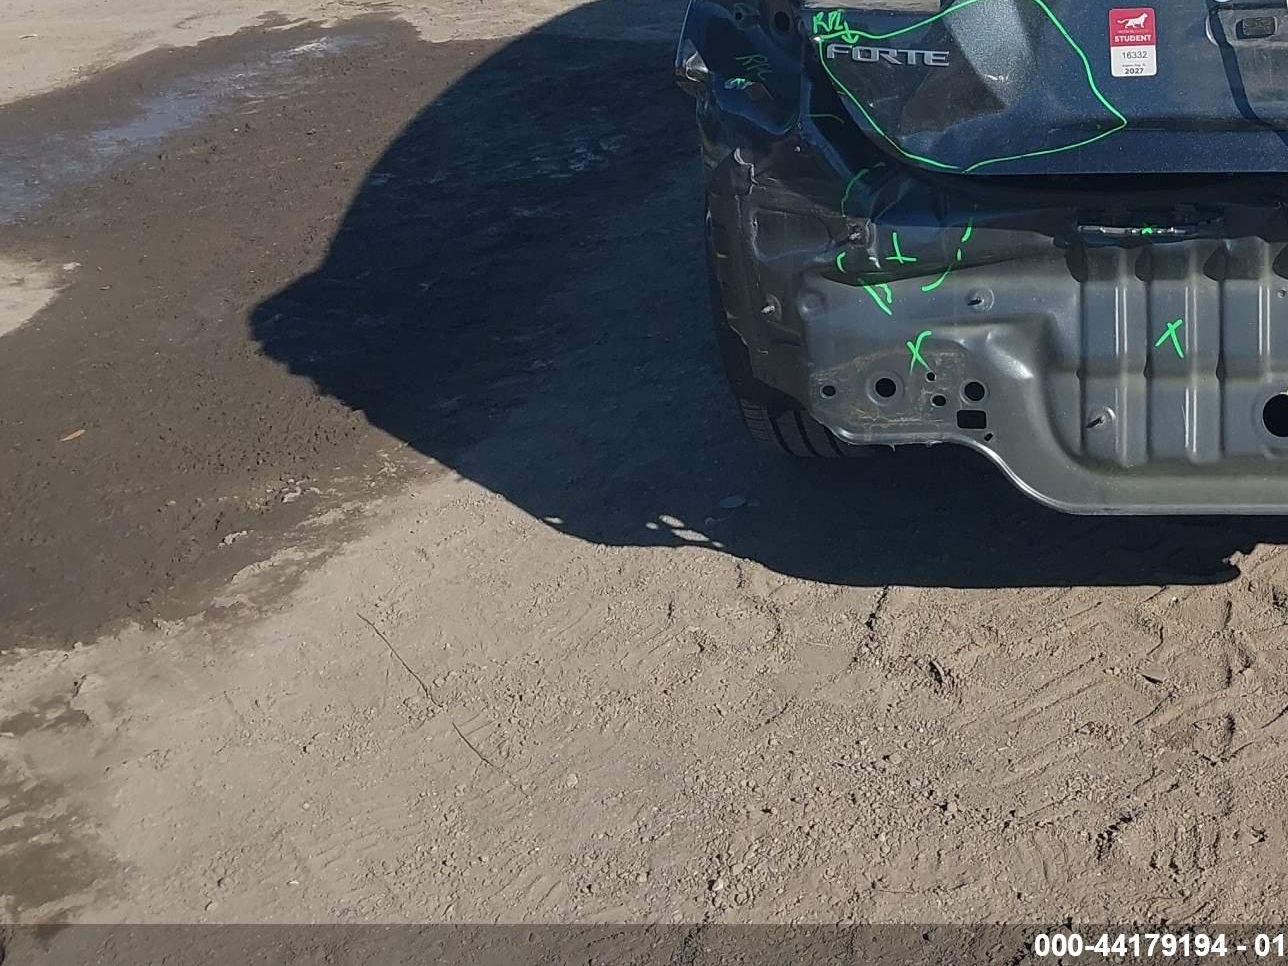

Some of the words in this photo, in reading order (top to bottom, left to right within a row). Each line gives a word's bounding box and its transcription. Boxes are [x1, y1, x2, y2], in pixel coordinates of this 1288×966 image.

[1114, 34, 1152, 43] STUDENT
[826, 43, 950, 67] FORTE
[1124, 67, 1145, 75] 2027
